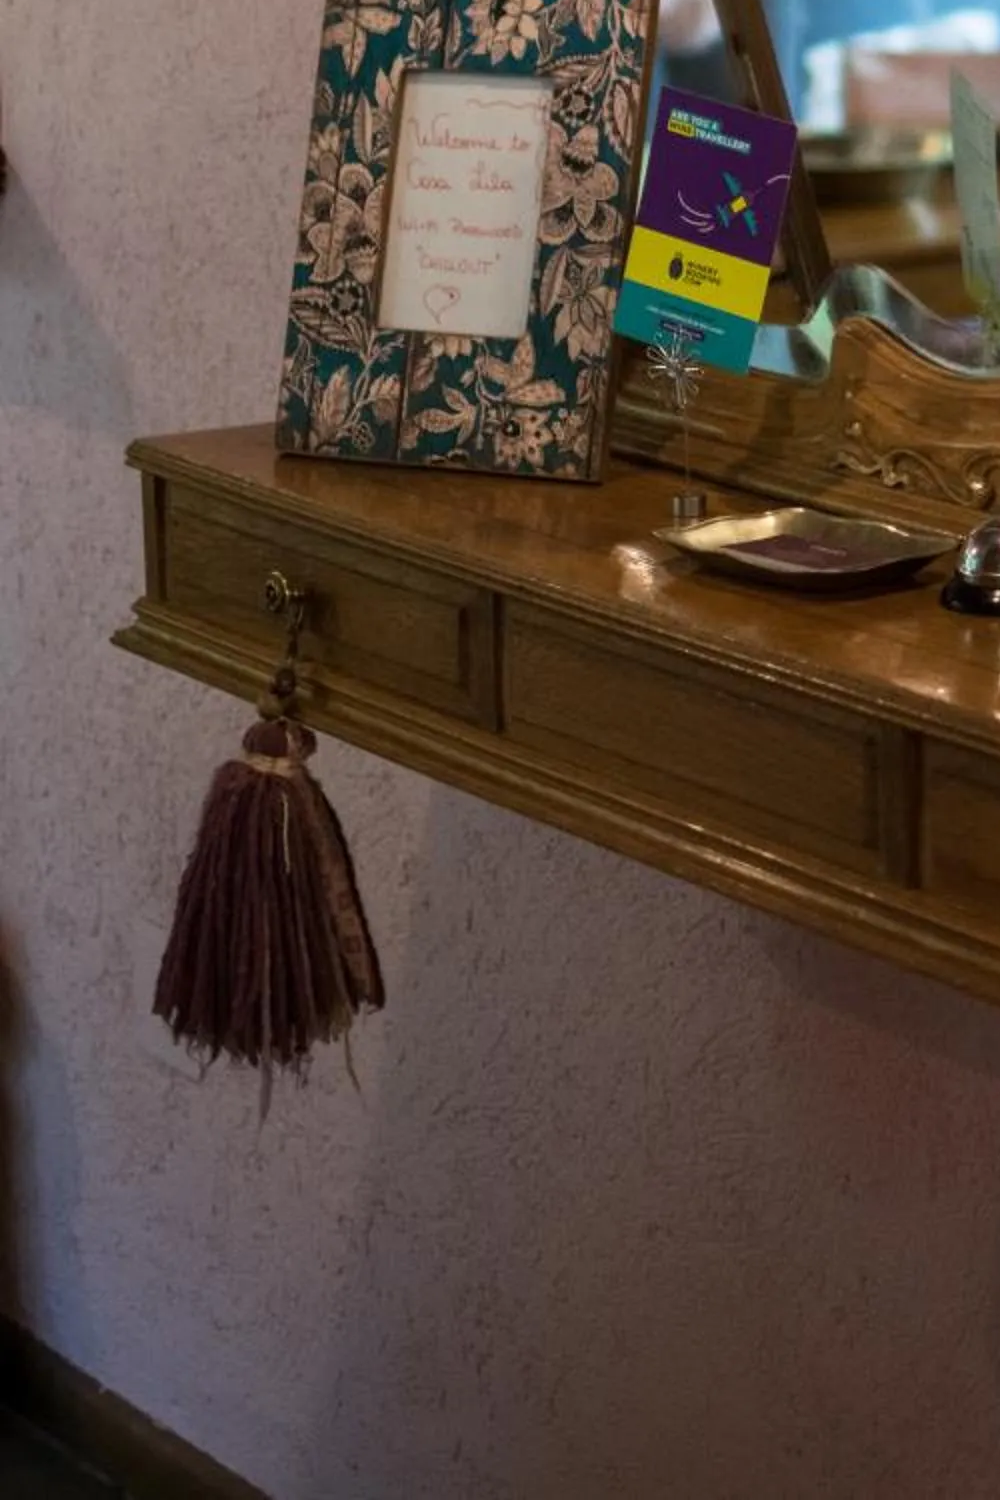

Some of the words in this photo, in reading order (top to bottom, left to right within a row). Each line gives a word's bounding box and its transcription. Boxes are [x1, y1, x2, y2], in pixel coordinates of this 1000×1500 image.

[408, 112, 502, 150] Welcome
[509, 131, 530, 151] to
[691, 114, 710, 130] YOU
